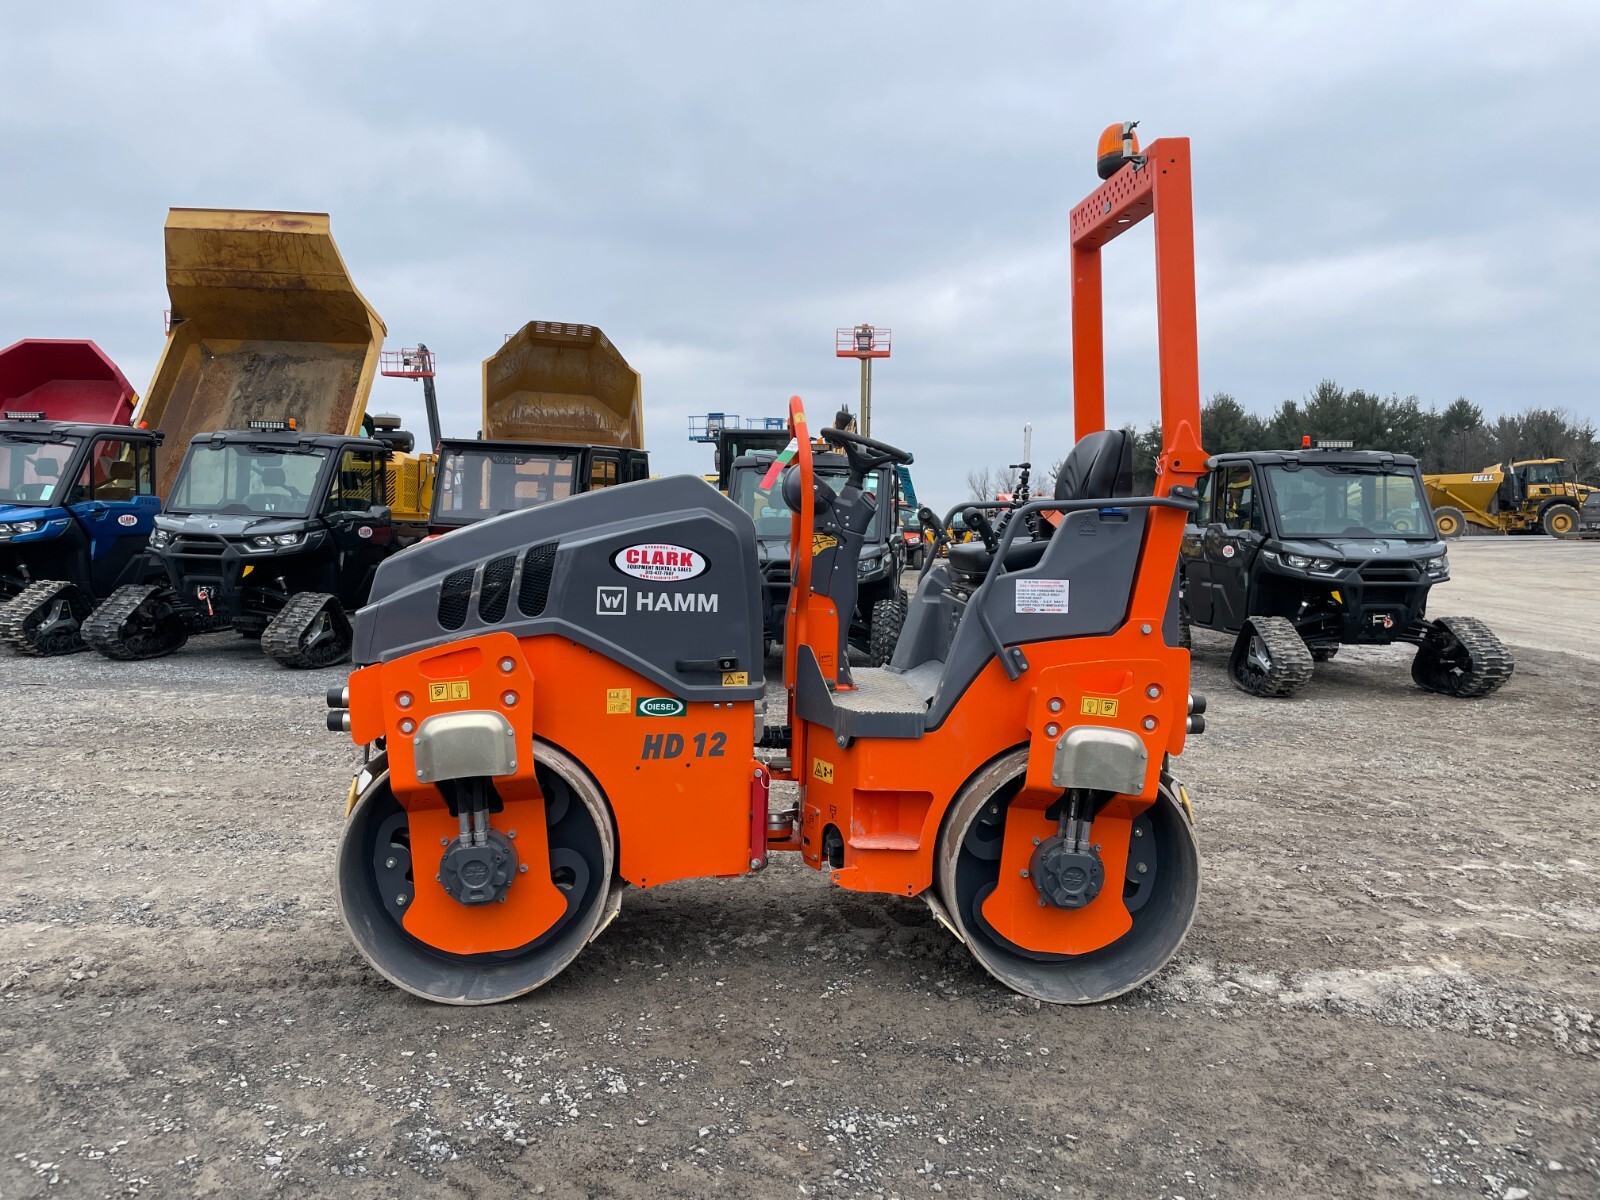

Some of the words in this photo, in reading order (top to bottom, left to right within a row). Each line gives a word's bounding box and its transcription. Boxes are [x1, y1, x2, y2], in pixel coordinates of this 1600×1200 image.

[493, 456, 523, 464] Kubota
[1472, 474, 1494, 482] BELL
[626, 549, 694, 567] CLARK
[636, 591, 718, 613] HAMM
[647, 703, 676, 711] DIESEL
[641, 733, 685, 760] HD
[693, 731, 728, 757] 12
